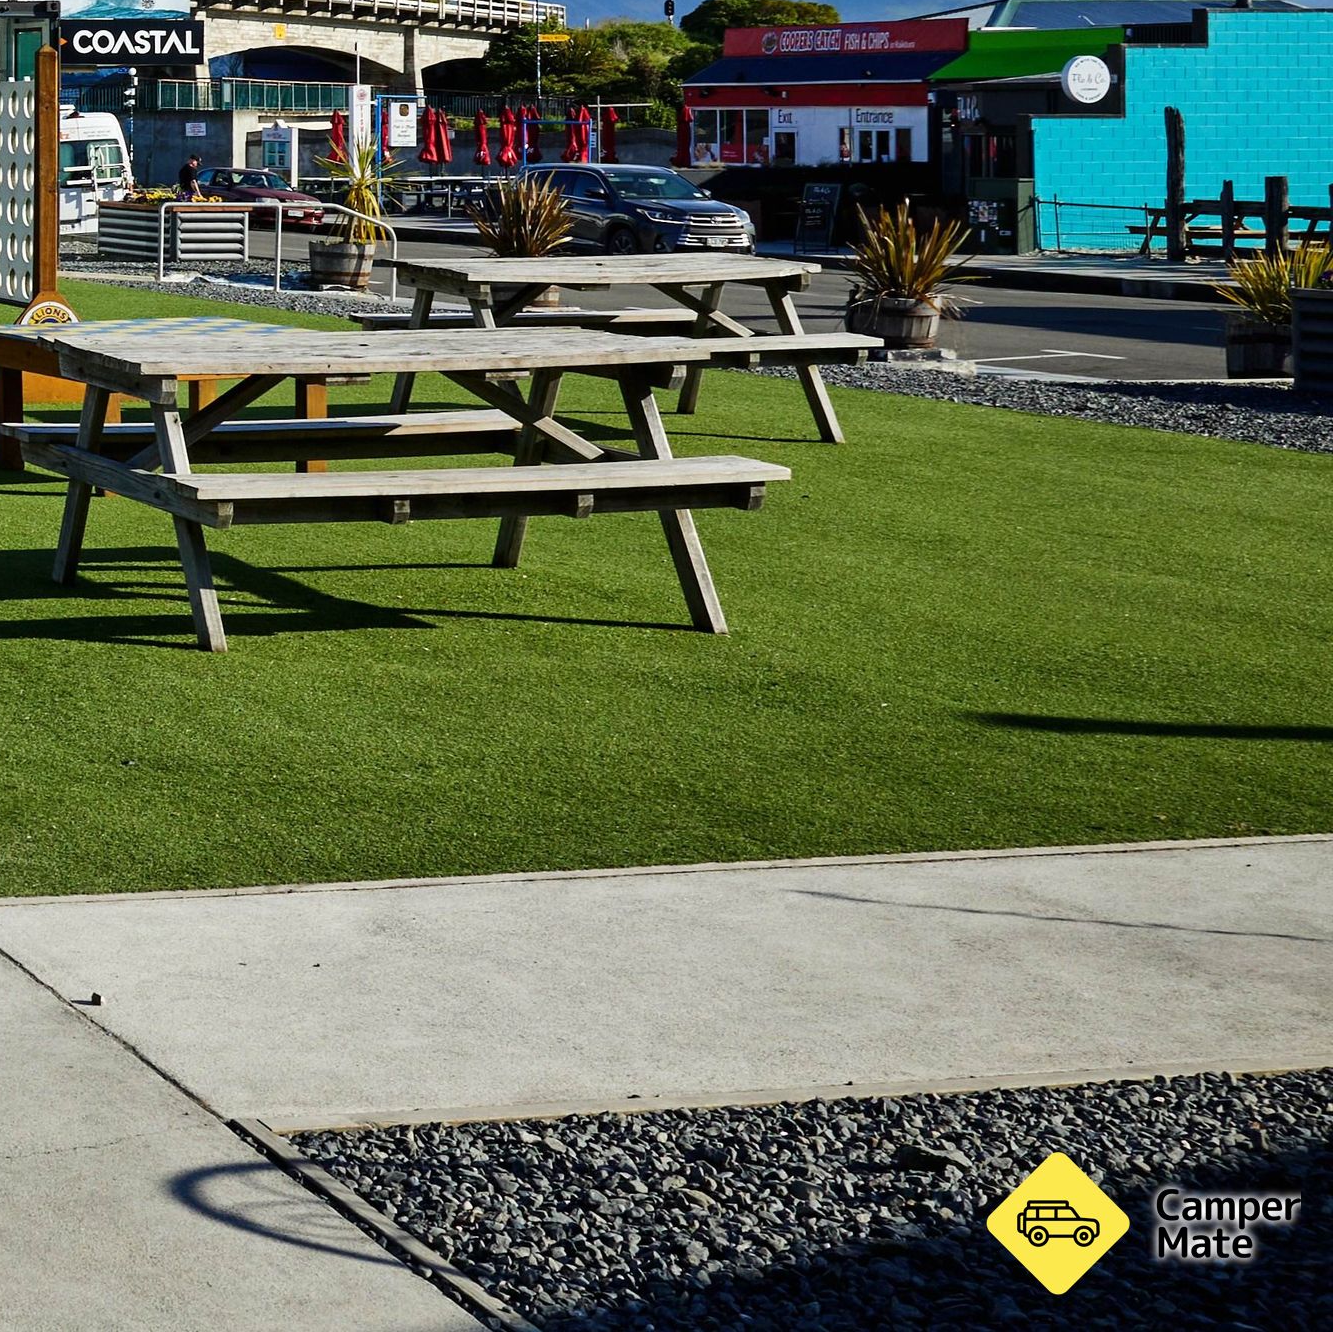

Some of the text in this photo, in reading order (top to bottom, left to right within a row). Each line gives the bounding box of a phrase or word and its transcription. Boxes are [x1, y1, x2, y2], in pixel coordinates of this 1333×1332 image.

[72, 29, 200, 55] COASTAL
[780, 30, 814, 52] COOPERS
[814, 29, 842, 51] CATCH
[844, 32, 860, 50] FISH
[861, 33, 867, 50] &
[868, 31, 890, 50] CHIPS
[778, 108, 793, 124] Exit
[856, 108, 894, 124] Entrance
[35, 307, 67, 320] LIONS
